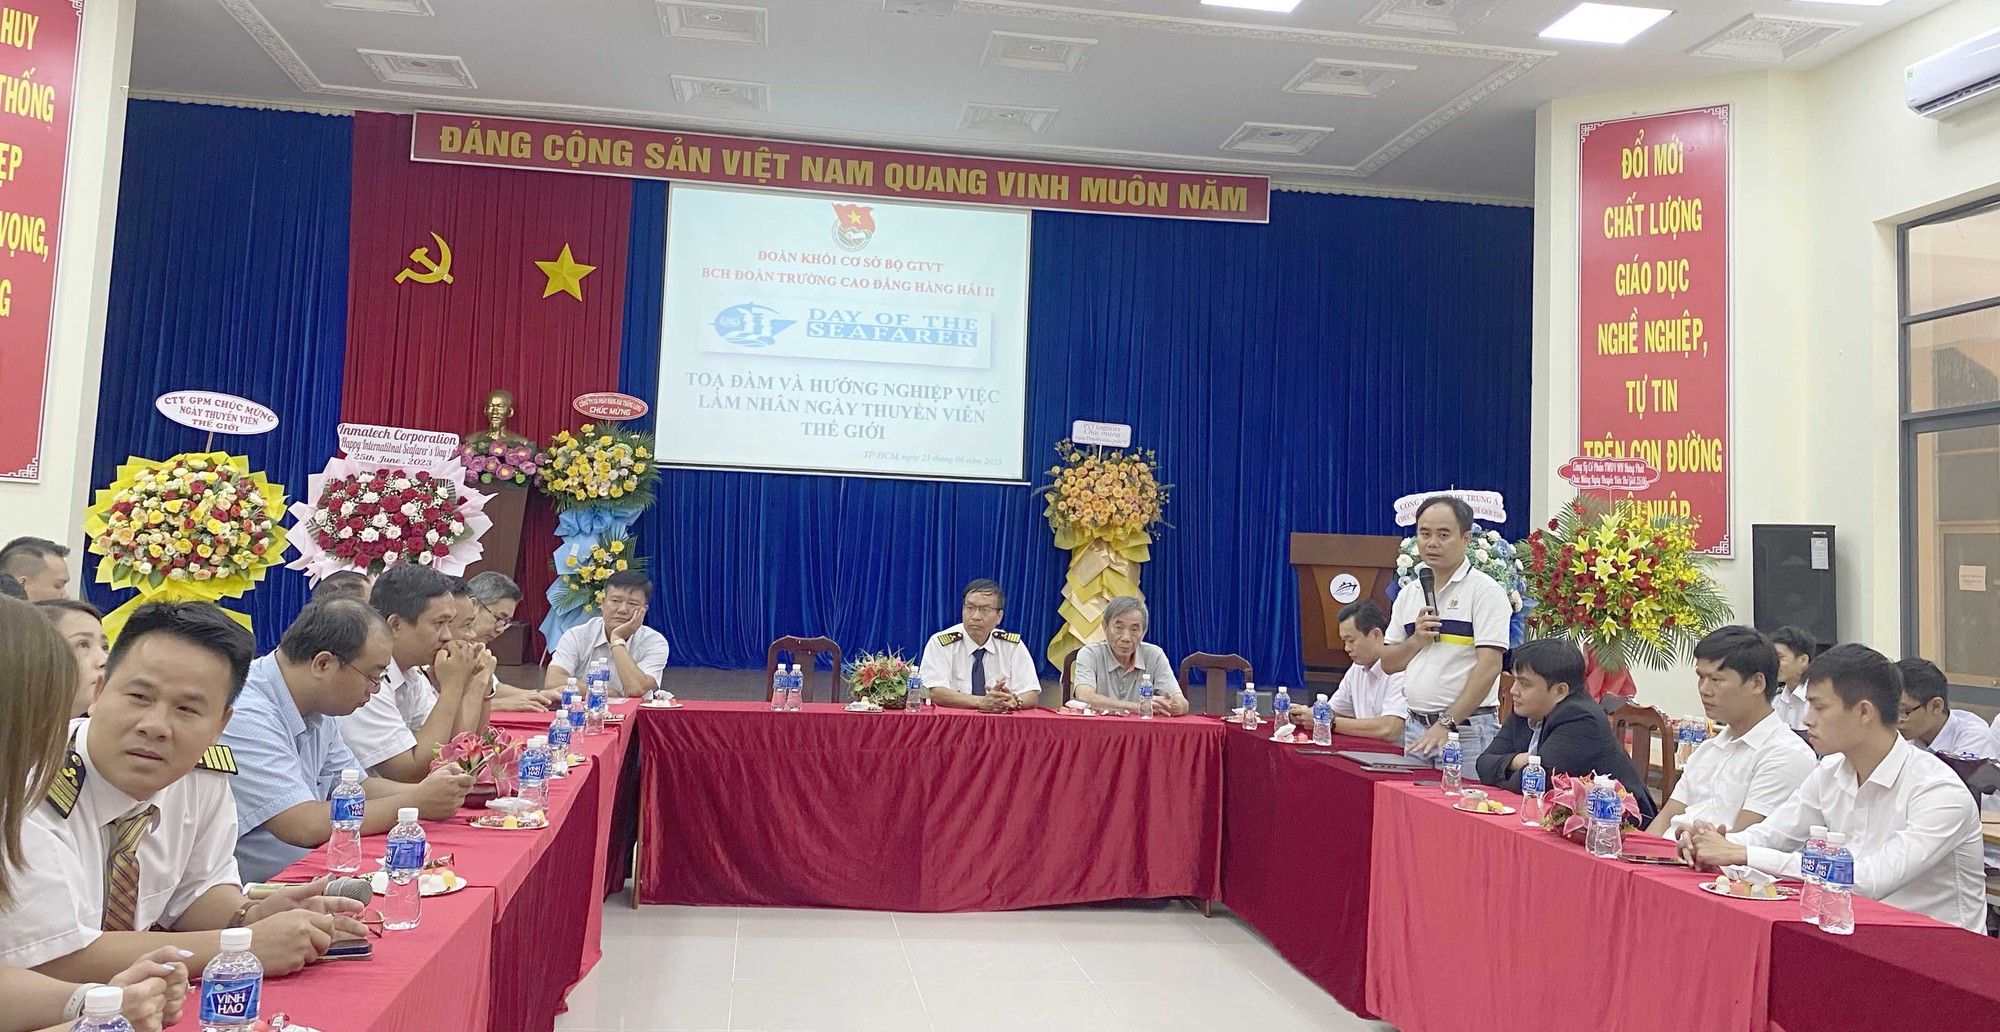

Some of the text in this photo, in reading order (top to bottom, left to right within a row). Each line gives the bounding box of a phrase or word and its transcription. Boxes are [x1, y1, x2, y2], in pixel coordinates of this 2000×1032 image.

[1, 7, 39, 51] HUY
[0, 142, 23, 187] ẸP
[439, 120, 1248, 212] ĐẢNG CỘNG SẢN VIỆT NAM QUANG VINH MUÔN NĂM
[1621, 128, 1684, 180] ĐỔI MỚI
[1603, 192, 1703, 240] CHẤT LƯỢNG
[758, 249, 798, 263] ĐOÀN
[840, 256, 861, 267] CƠ
[906, 261, 943, 273] GTVT
[702, 267, 731, 280] BCH
[734, 268, 775, 282] ĐOÀN
[778, 272, 837, 287] TRƯỜNG
[840, 277, 870, 289] CAO
[915, 281, 954, 294] HÀNG
[1615, 254, 1690, 299] GIÁO DỤC
[808, 307, 978, 331] DAY OF THE
[808, 322, 976, 347] SEAFARER
[1598, 307, 1707, 358] NGHỀ NGHIỆP,
[731, 371, 774, 390] ĐÀM
[779, 374, 804, 392] VÀ
[810, 376, 878, 396] HƯỚNG
[164, 396, 186, 405] CTY
[189, 396, 212, 406] GPM
[214, 400, 244, 411] CHÚC
[589, 404, 608, 415] CHÚC
[746, 394, 800, 413] NHÂN
[804, 398, 859, 416] NGÀY
[942, 405, 987, 424] VIÊN
[1625, 374, 1678, 420] TỰ TIN
[179, 405, 205, 417] NGÀY
[339, 423, 457, 445] Inmatech Corporation
[843, 421, 886, 440] GIỚI
[341, 436, 361, 453] Happy
[1667, 430, 1723, 473] ĐƯỜNG
[354, 452, 375, 462] 25th
[408, 457, 432, 467] 2023
[1466, 494, 1492, 504] TRUNG
